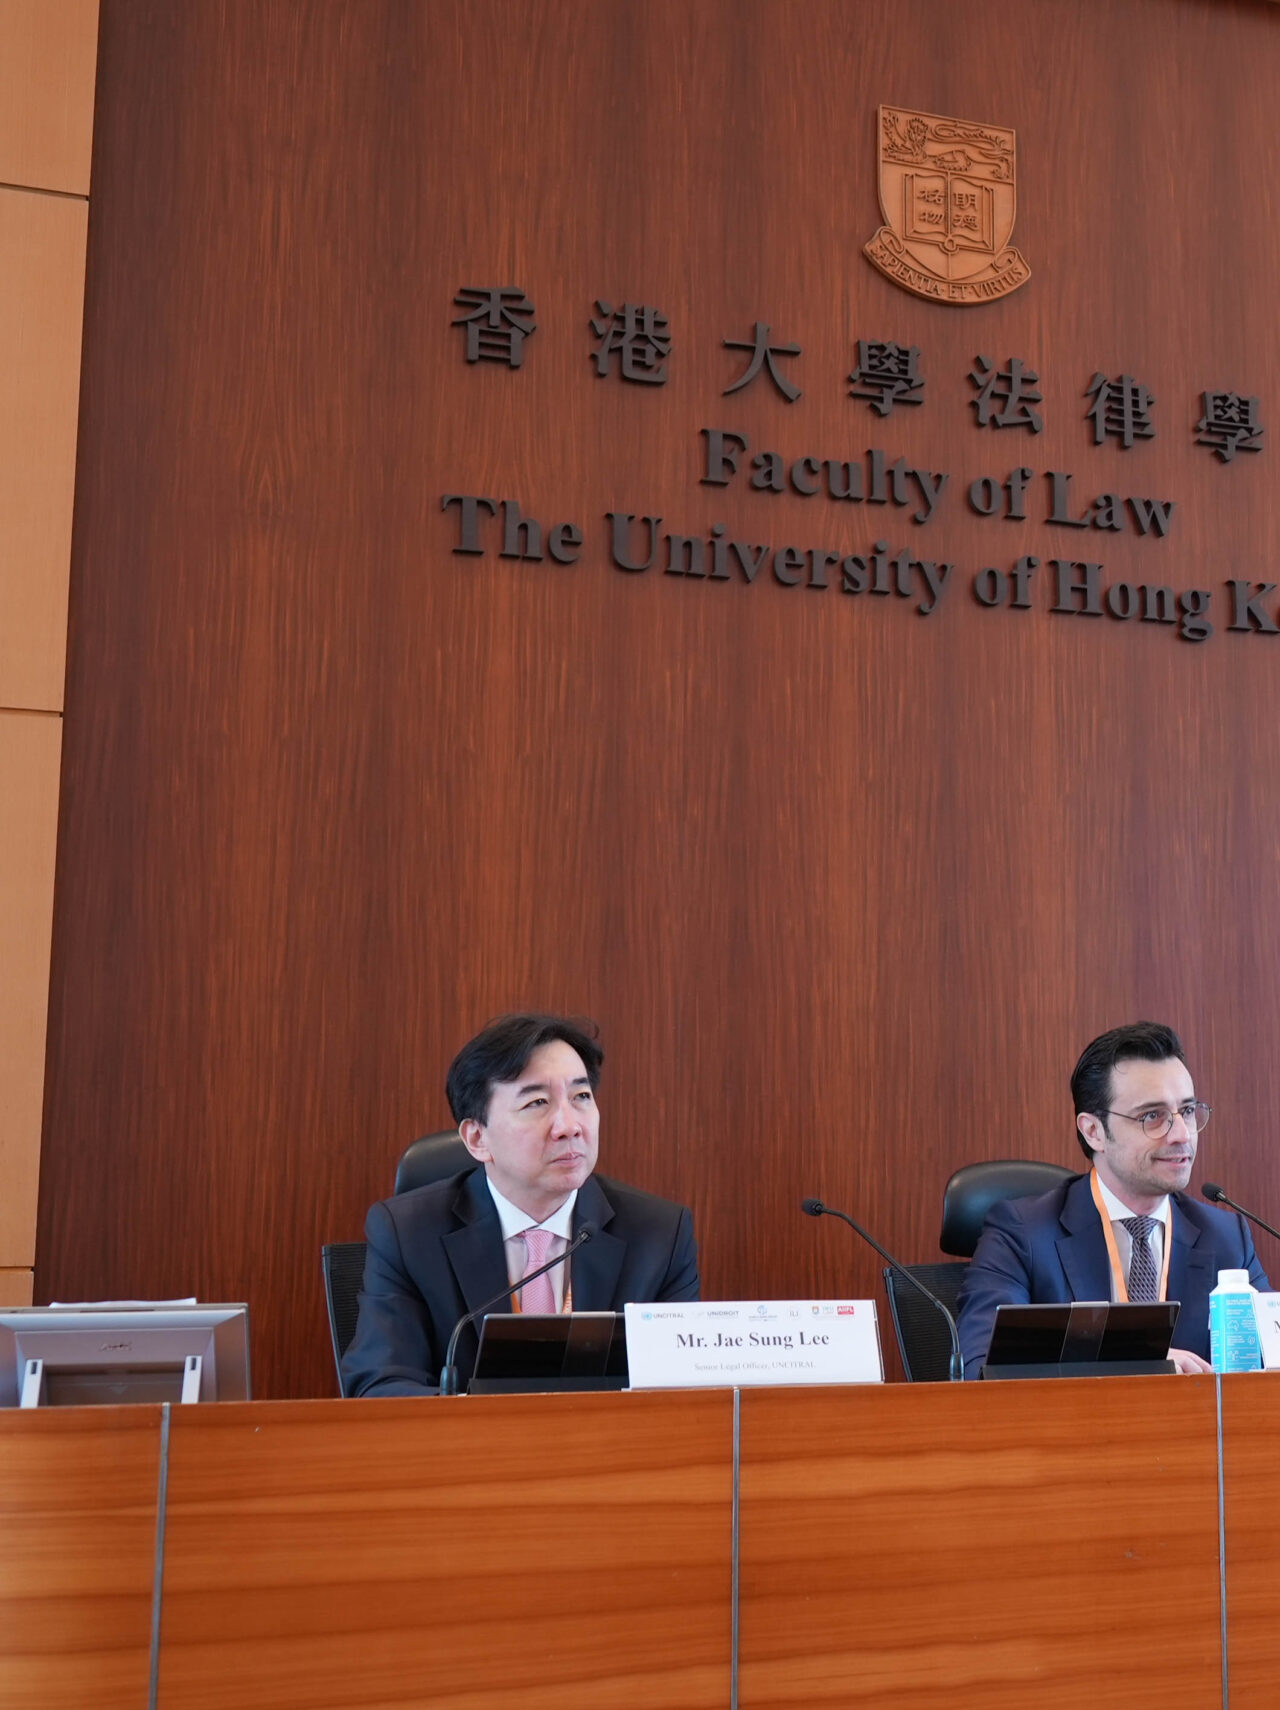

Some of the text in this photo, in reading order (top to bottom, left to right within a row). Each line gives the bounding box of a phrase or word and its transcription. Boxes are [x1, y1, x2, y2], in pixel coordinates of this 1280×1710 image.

[700, 428, 1177, 537] Faculty of Law
[441, 493, 583, 564] The
[604, 512, 955, 615] University
[973, 555, 1040, 609] of
[1049, 558, 1213, 642] Hong
[676, 1330, 830, 1350] Mr. Jae Sung Lee
